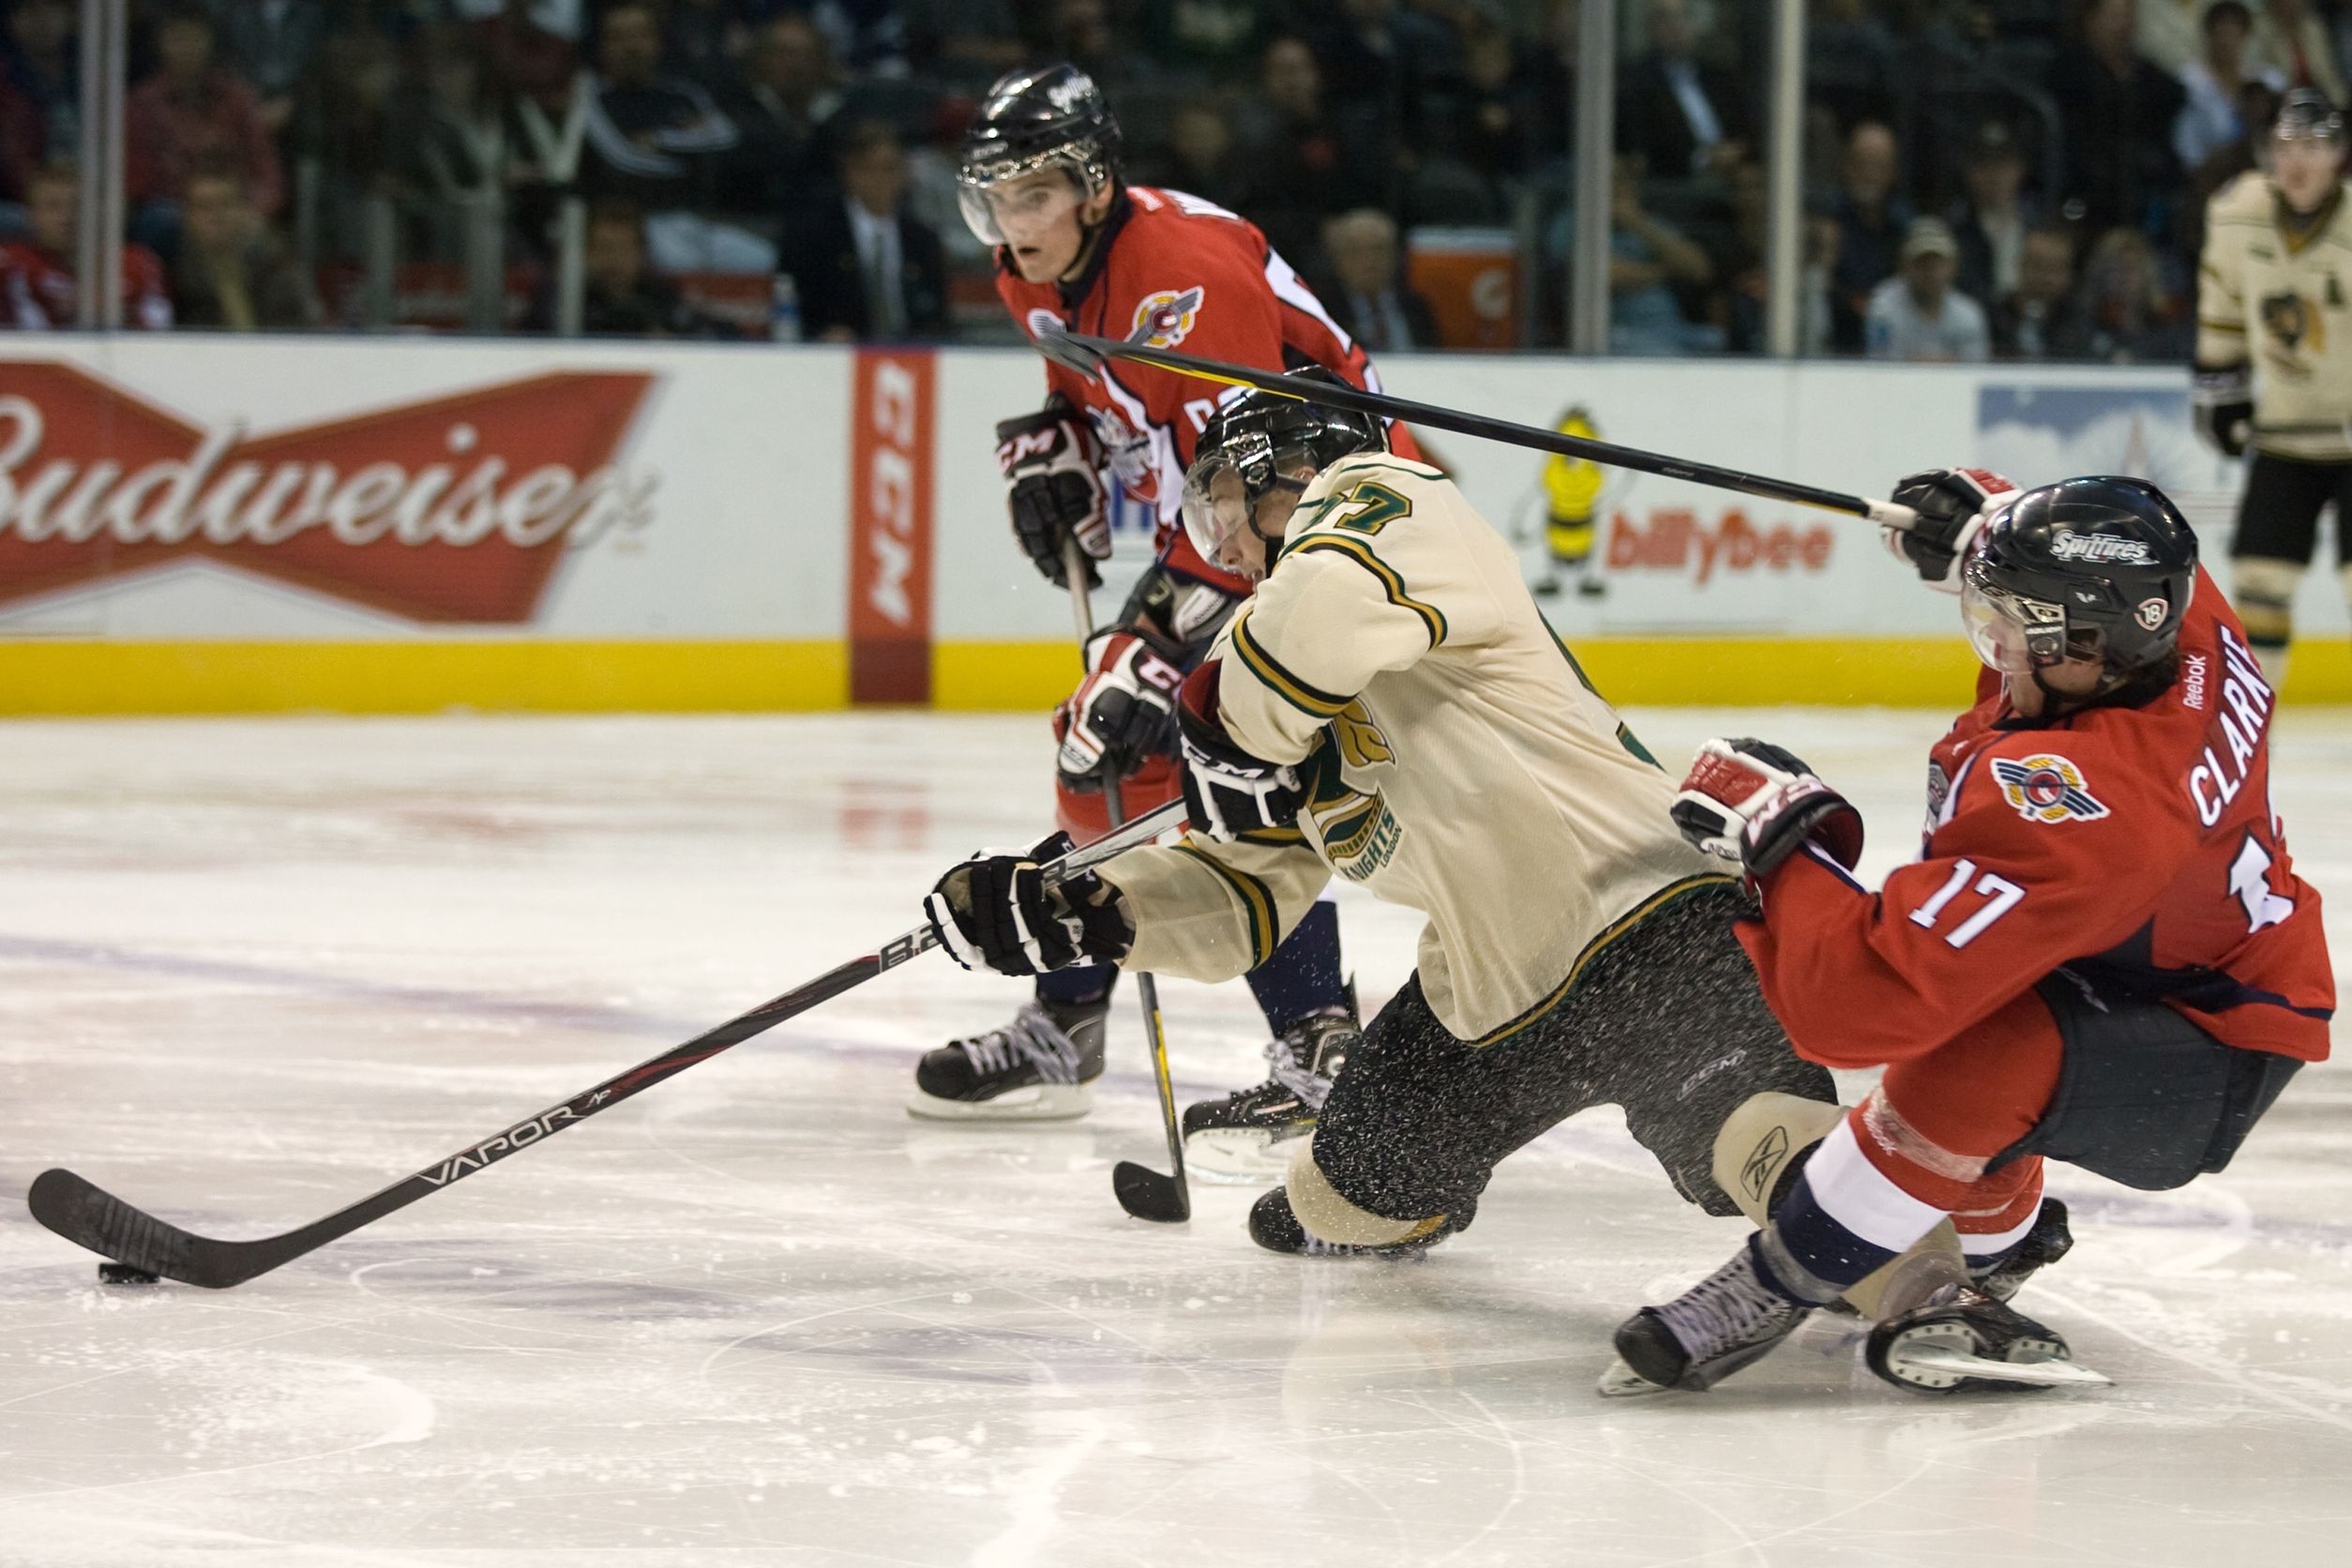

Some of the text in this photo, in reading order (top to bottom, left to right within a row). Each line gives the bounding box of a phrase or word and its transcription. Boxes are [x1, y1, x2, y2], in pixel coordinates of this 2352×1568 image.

[871, 360, 915, 626] CCM
[2049, 529, 2153, 563] Spitfires
[2143, 604, 2162, 626] 18
[2183, 655, 2207, 710] Reebok
[1339, 807, 1395, 882] KNIGHTS
[1380, 824, 1403, 868] LONDON
[1907, 857, 2027, 950] 17
[416, 1105, 589, 1184] VAPOR
